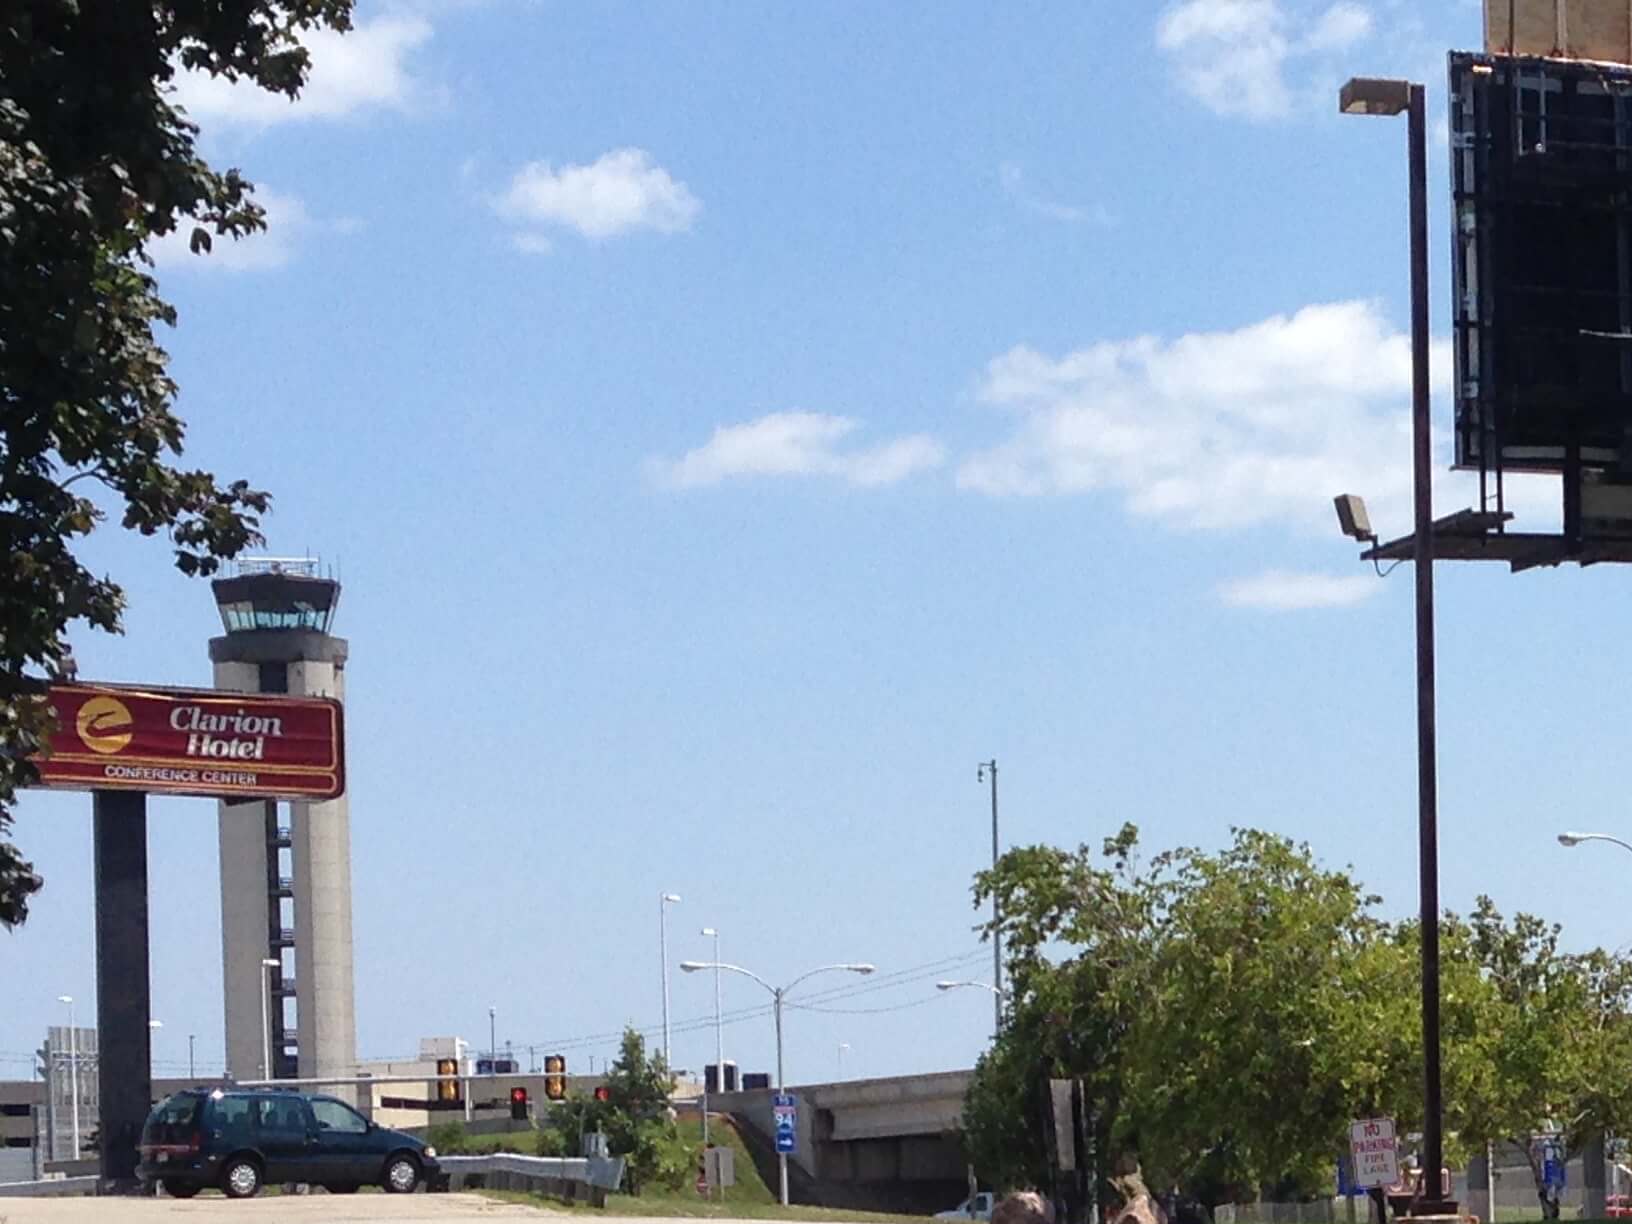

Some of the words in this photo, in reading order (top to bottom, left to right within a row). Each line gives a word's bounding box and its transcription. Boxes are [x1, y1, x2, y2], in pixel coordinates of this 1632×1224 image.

[169, 706, 283, 736] Clarion
[186, 734, 264, 760] Hotel
[104, 764, 199, 783] CONFERENCE
[201, 769, 257, 785] CENTER
[1363, 1123, 1380, 1137] NO
[1352, 1138, 1394, 1153] PARKING
